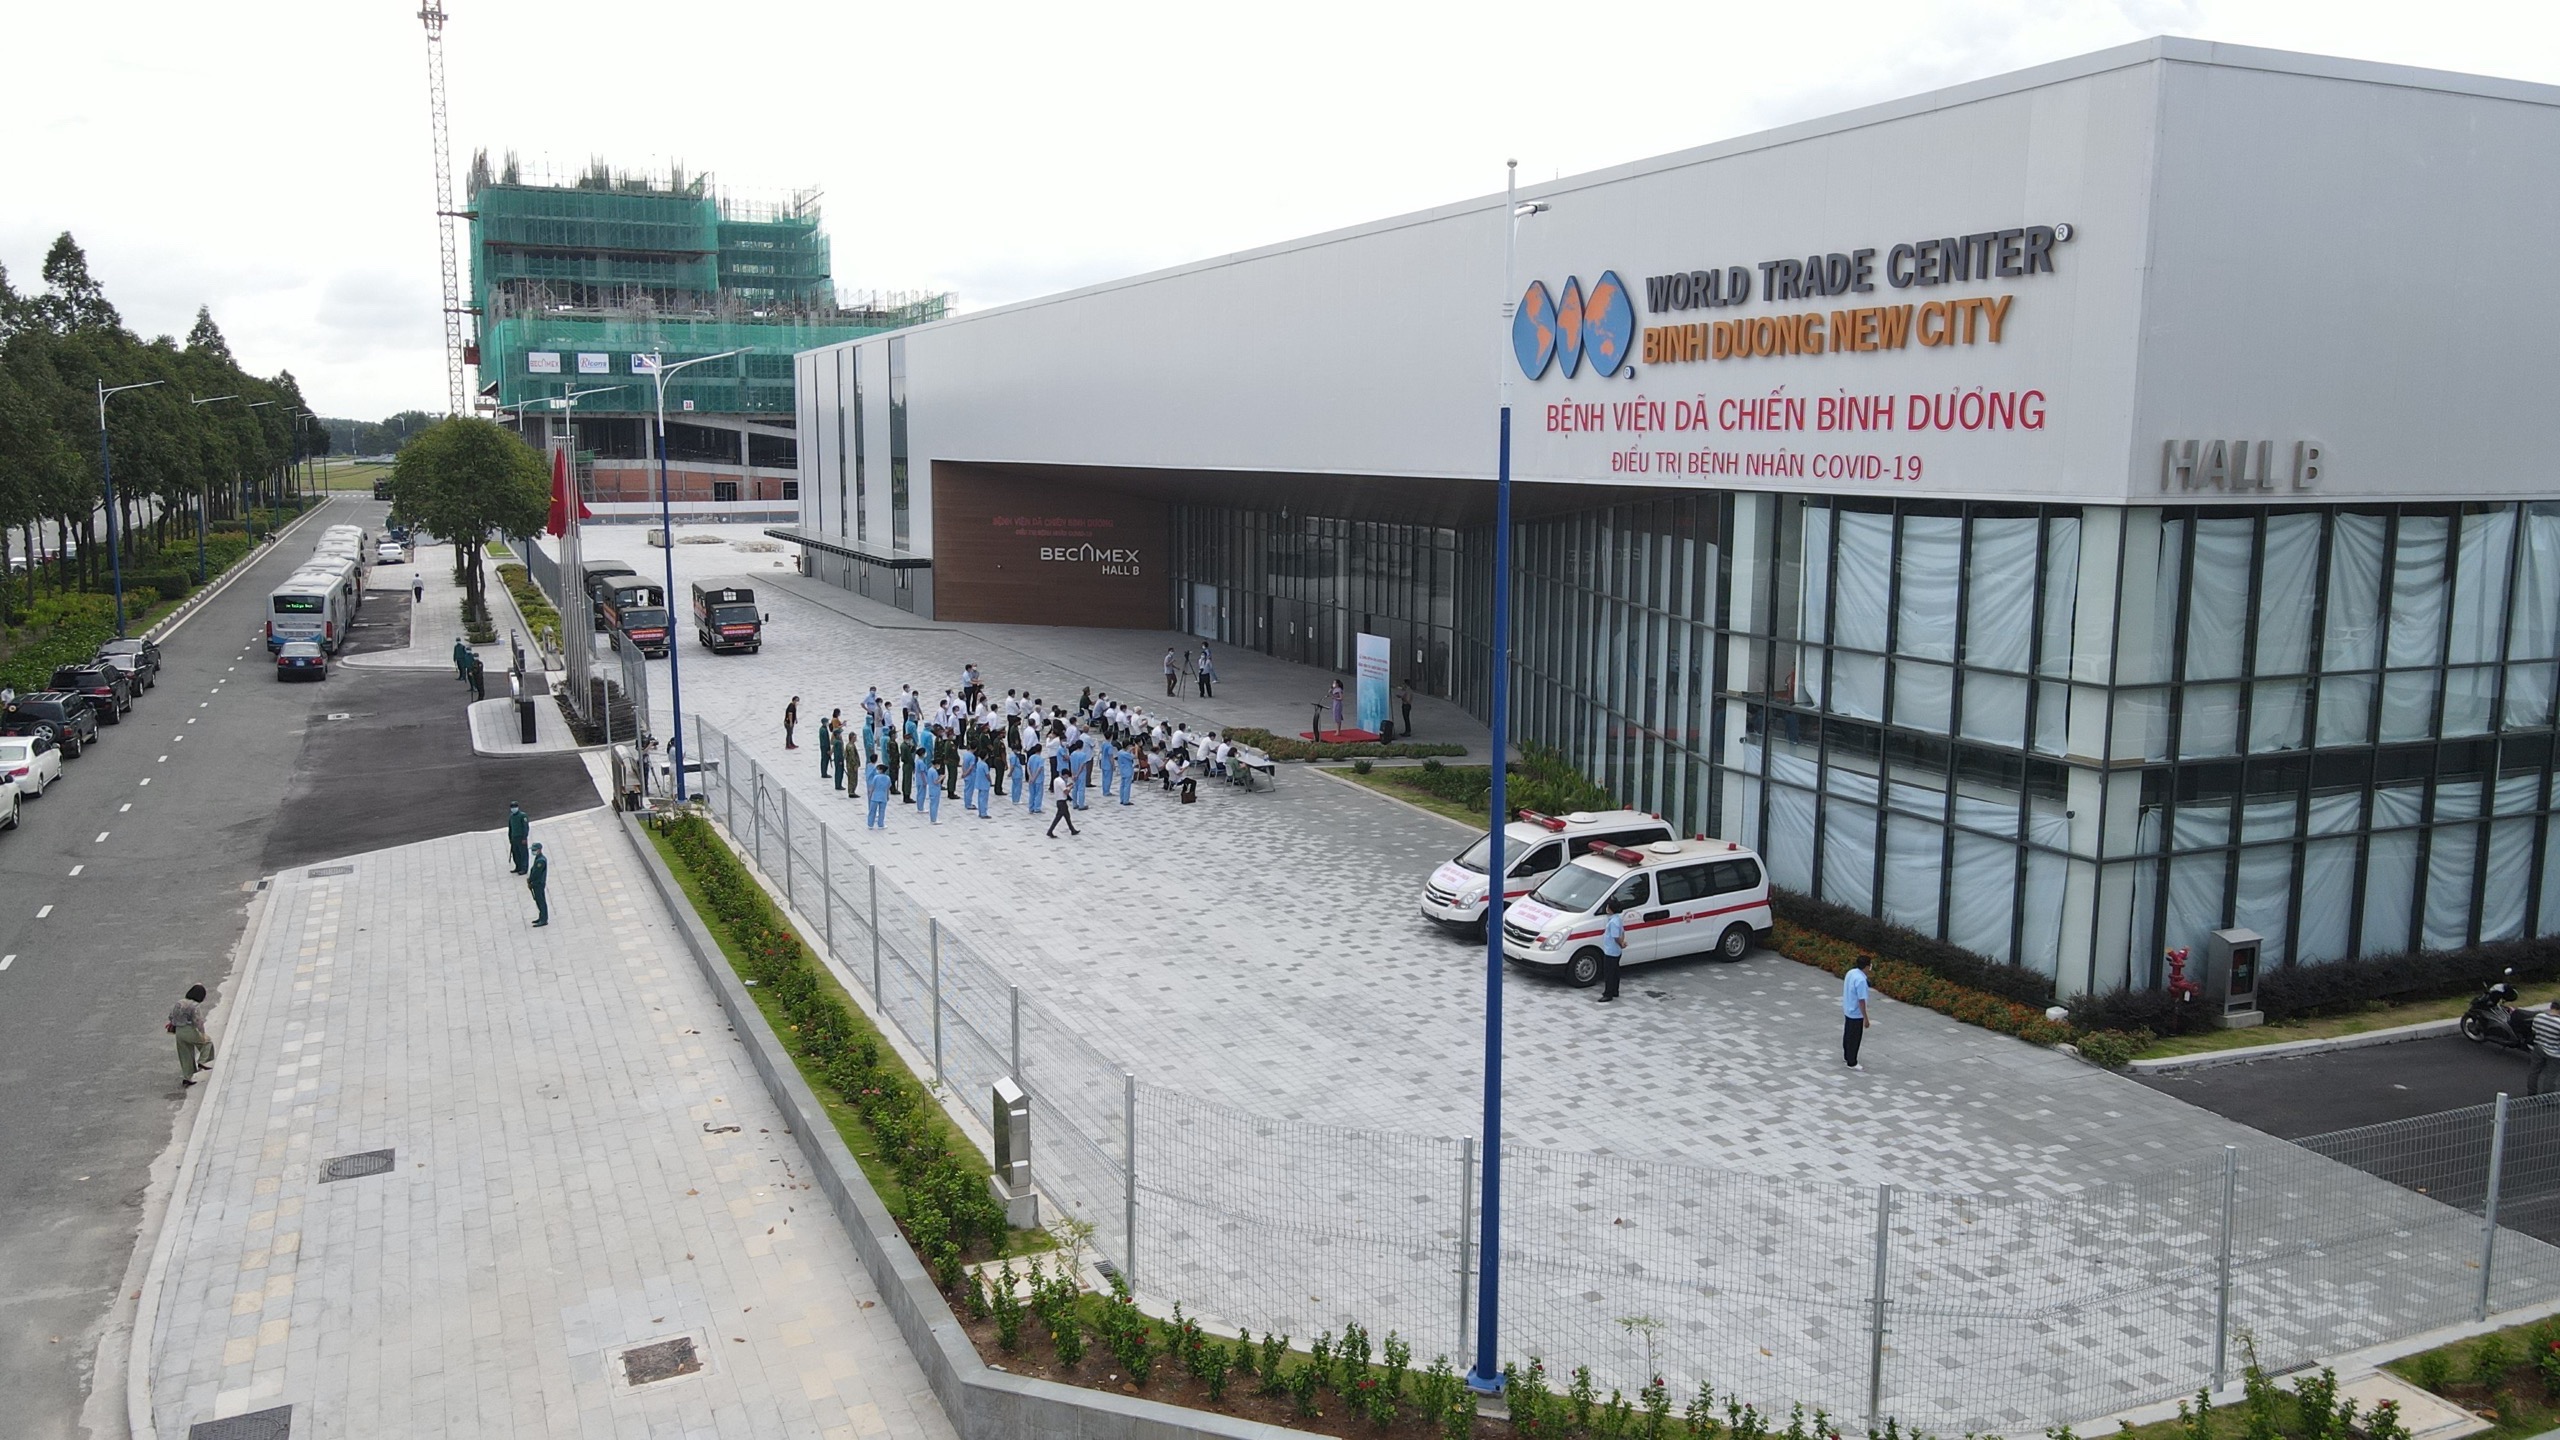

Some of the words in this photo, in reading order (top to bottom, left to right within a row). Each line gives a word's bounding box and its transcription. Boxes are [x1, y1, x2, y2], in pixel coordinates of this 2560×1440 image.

[1646, 266, 1750, 313] WORLD
[1758, 248, 1875, 302] TRADE
[1643, 323, 1707, 364] BINH
[1712, 313, 1825, 360] DUONG
[1829, 304, 1913, 352] NEW
[1916, 295, 2013, 347] CITY
[1547, 397, 1604, 438] BỆNH
[1613, 394, 1665, 438] VIỆN
[1675, 393, 1709, 431] DÃ
[1719, 385, 1806, 431] CHIẾN
[1817, 388, 1895, 431] BÌNH
[1908, 386, 2046, 431] DƯƠNG
[1612, 444, 1649, 473] ĐIỀU
[1656, 451, 1681, 479] TRỊ
[1688, 447, 1738, 479] BỆNH
[1746, 448, 1804, 477] NHÂN
[1812, 453, 1923, 482] COVID-19
[2161, 439, 2282, 492] HALL
[2292, 440, 2326, 491] B
[1040, 543, 1140, 563] BECAMEX
[1102, 564, 1130, 576] HALL
[1133, 565, 1140, 576] B
